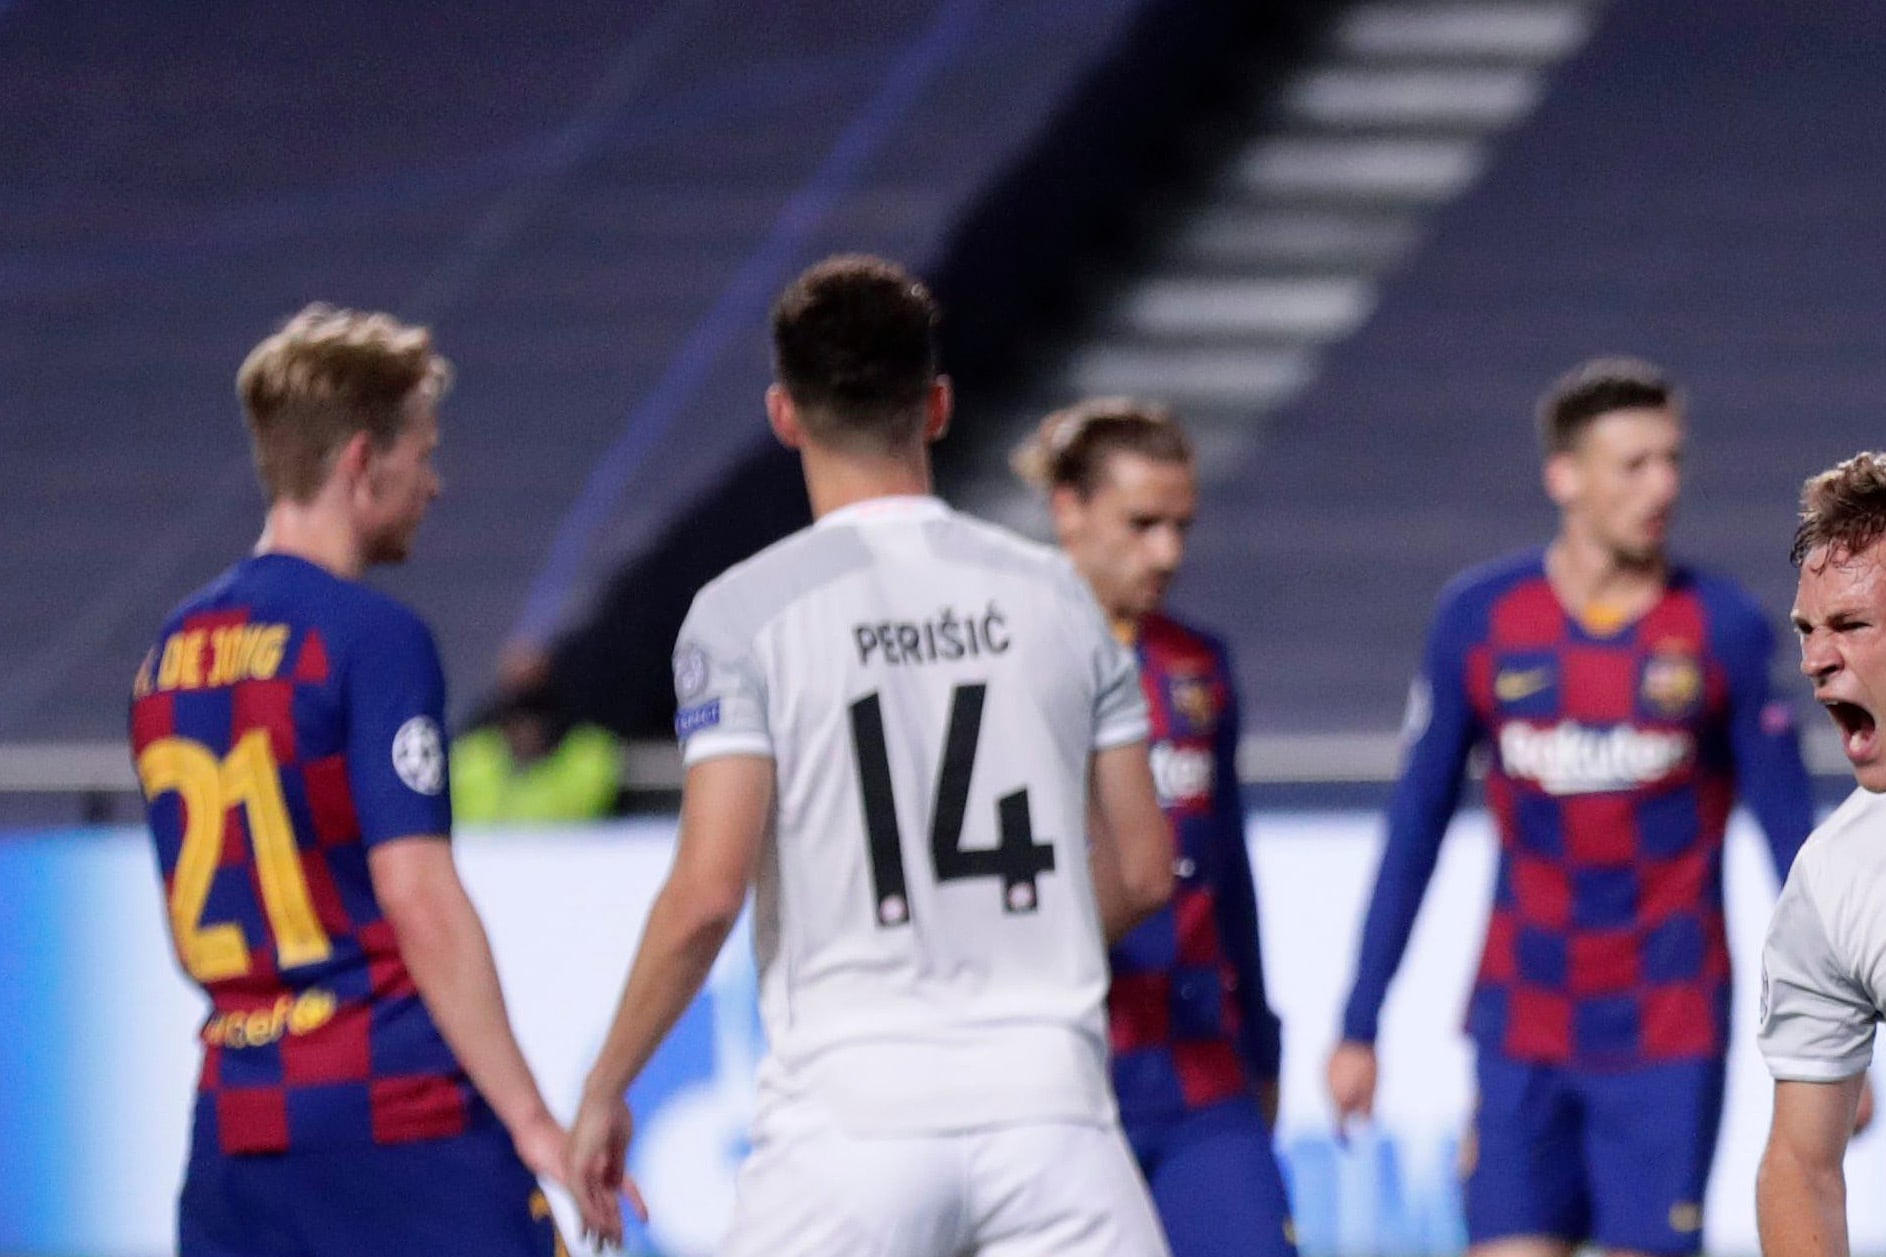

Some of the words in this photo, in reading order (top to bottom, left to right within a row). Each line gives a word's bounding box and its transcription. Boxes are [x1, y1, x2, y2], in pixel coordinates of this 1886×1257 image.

[855, 602, 1009, 664] PERIŠIĆ
[138, 728, 334, 984] 21
[850, 682, 1055, 927] 14
